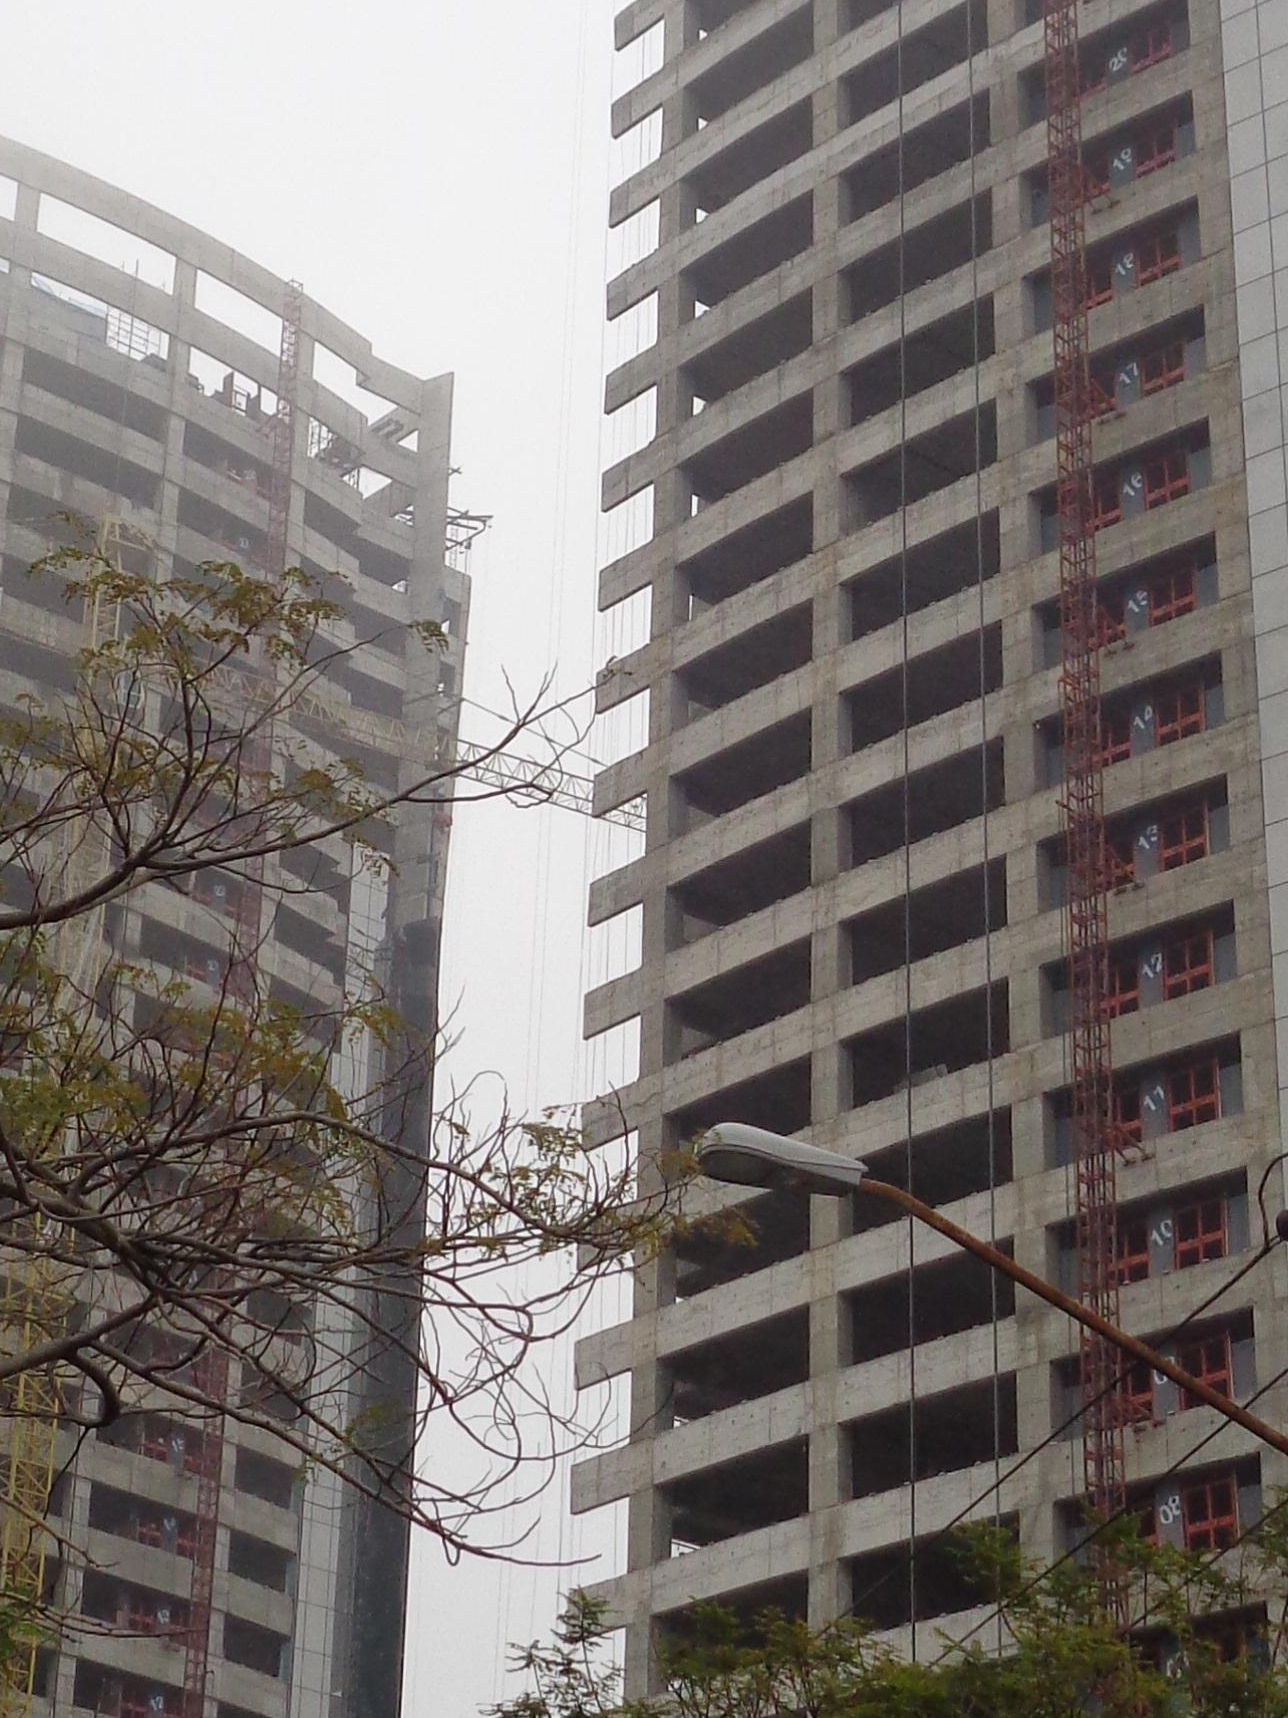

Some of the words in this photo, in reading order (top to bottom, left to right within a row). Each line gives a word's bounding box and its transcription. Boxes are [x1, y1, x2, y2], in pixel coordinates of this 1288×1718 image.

[1119, 362, 1138, 384] 17
[1151, 1219, 1172, 1245] 10
[1159, 1495, 1181, 1524] 08
